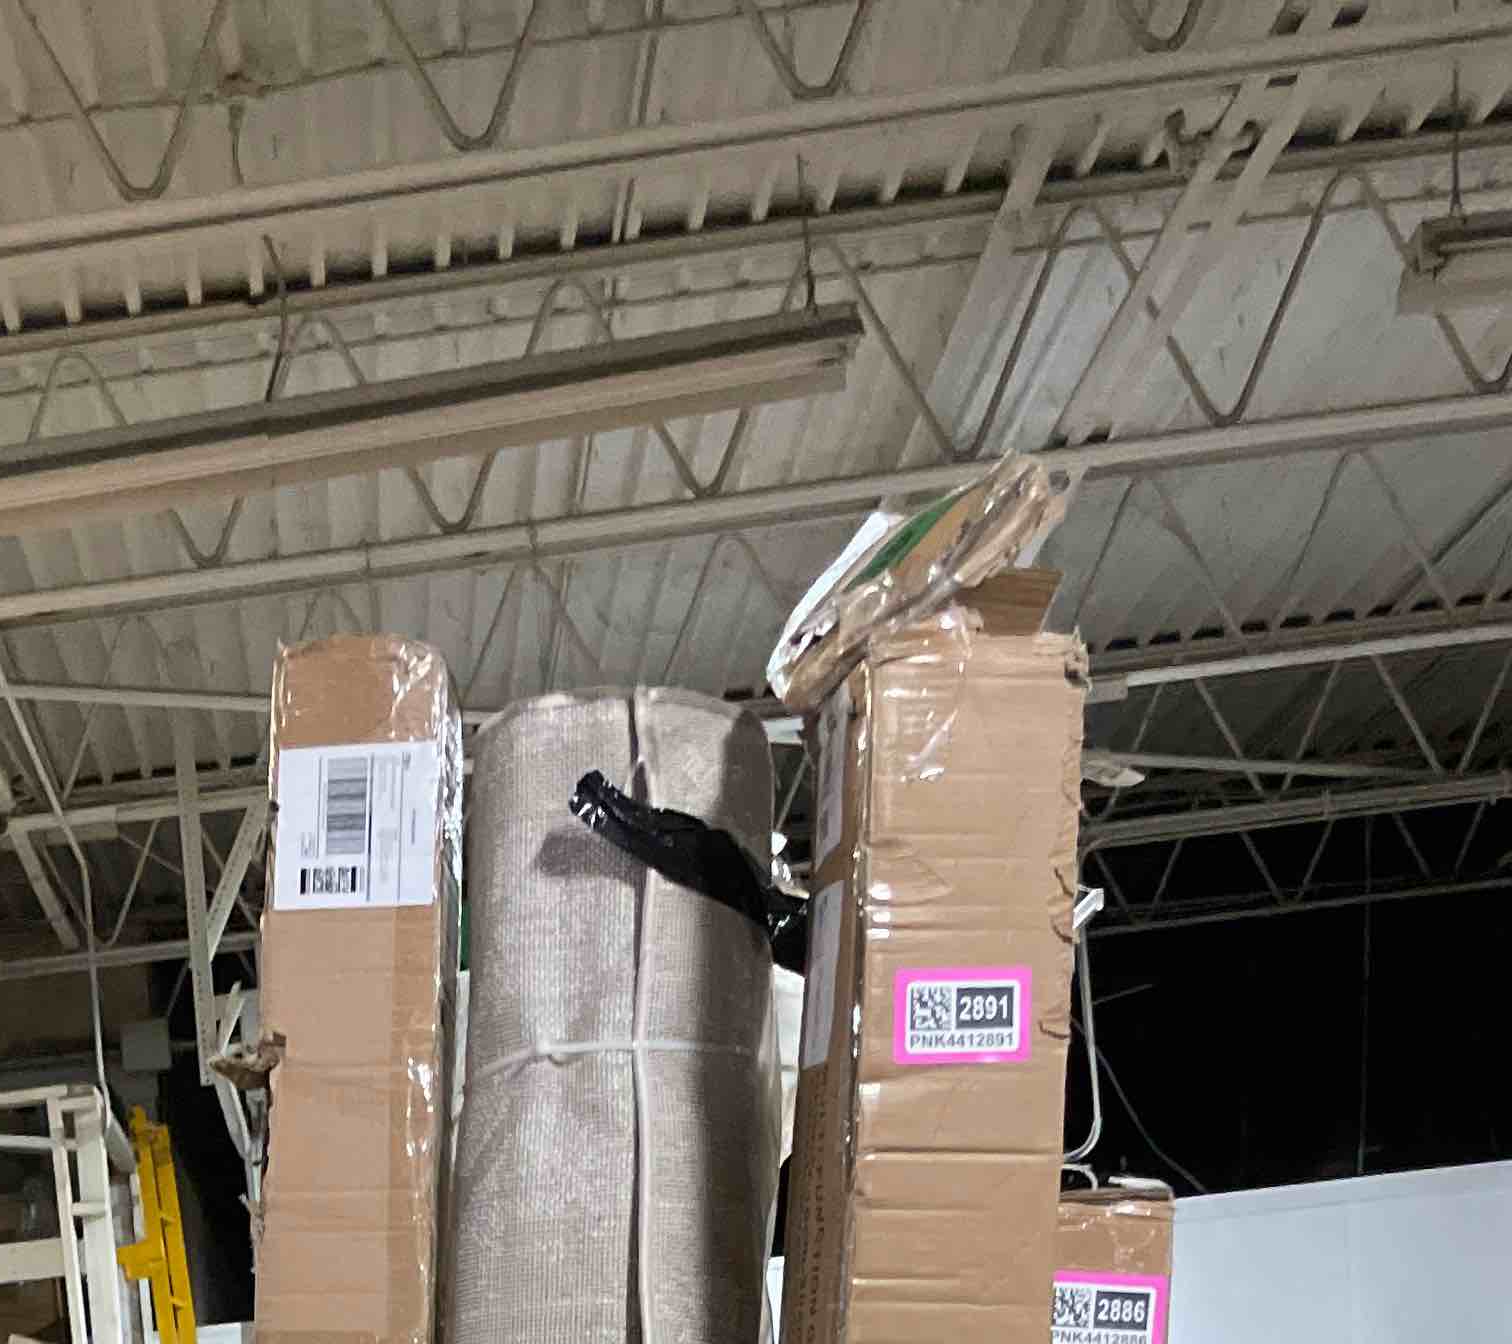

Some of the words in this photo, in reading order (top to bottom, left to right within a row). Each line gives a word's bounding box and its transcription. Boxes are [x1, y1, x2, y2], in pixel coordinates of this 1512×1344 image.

[958, 994, 1008, 1021] 2891
[910, 1032, 1014, 1049] PNK4412891
[1096, 1297, 1146, 1324] 2886
